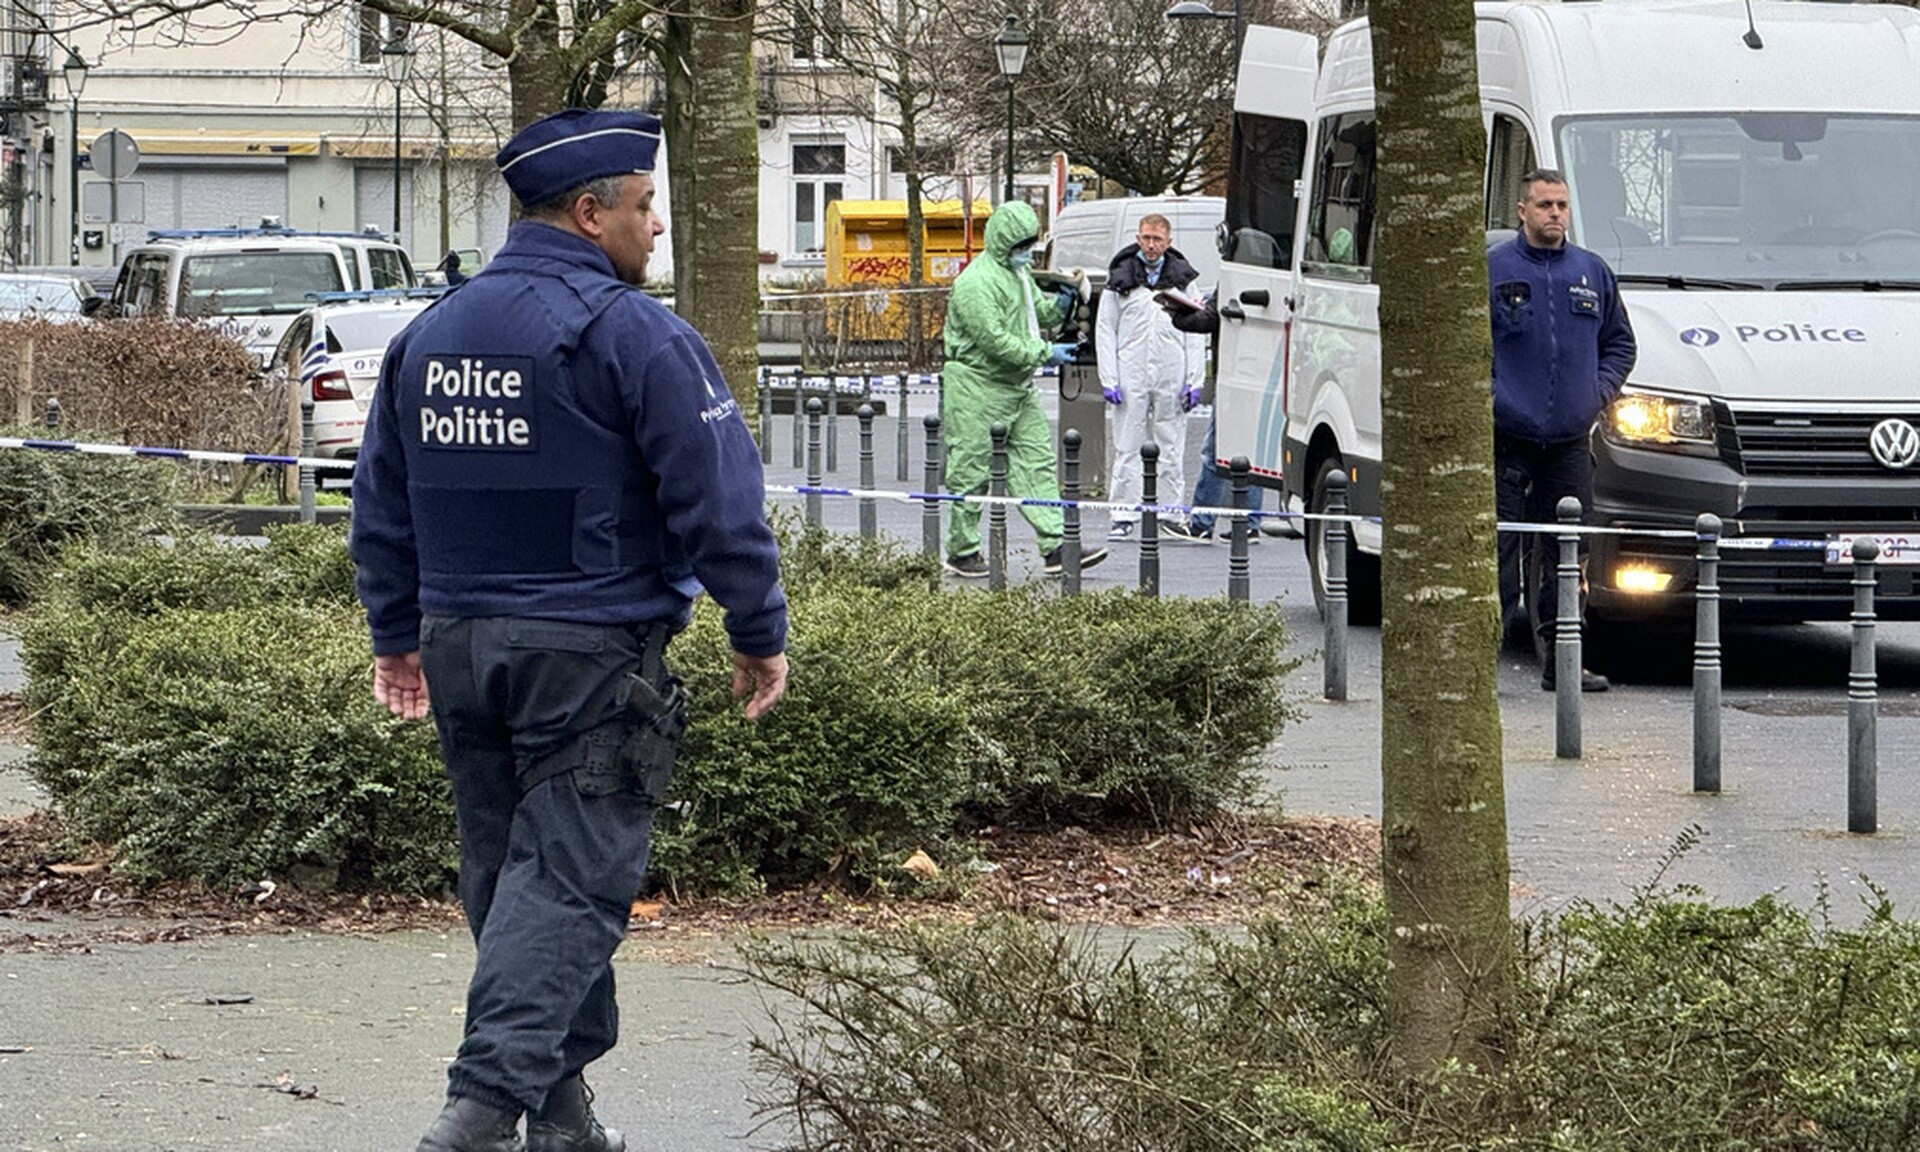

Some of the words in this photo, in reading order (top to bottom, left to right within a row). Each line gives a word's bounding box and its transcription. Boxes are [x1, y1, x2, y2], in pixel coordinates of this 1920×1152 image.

[1736, 323, 1867, 343] Police
[425, 358, 522, 398] Police
[420, 405, 530, 446] Politie
